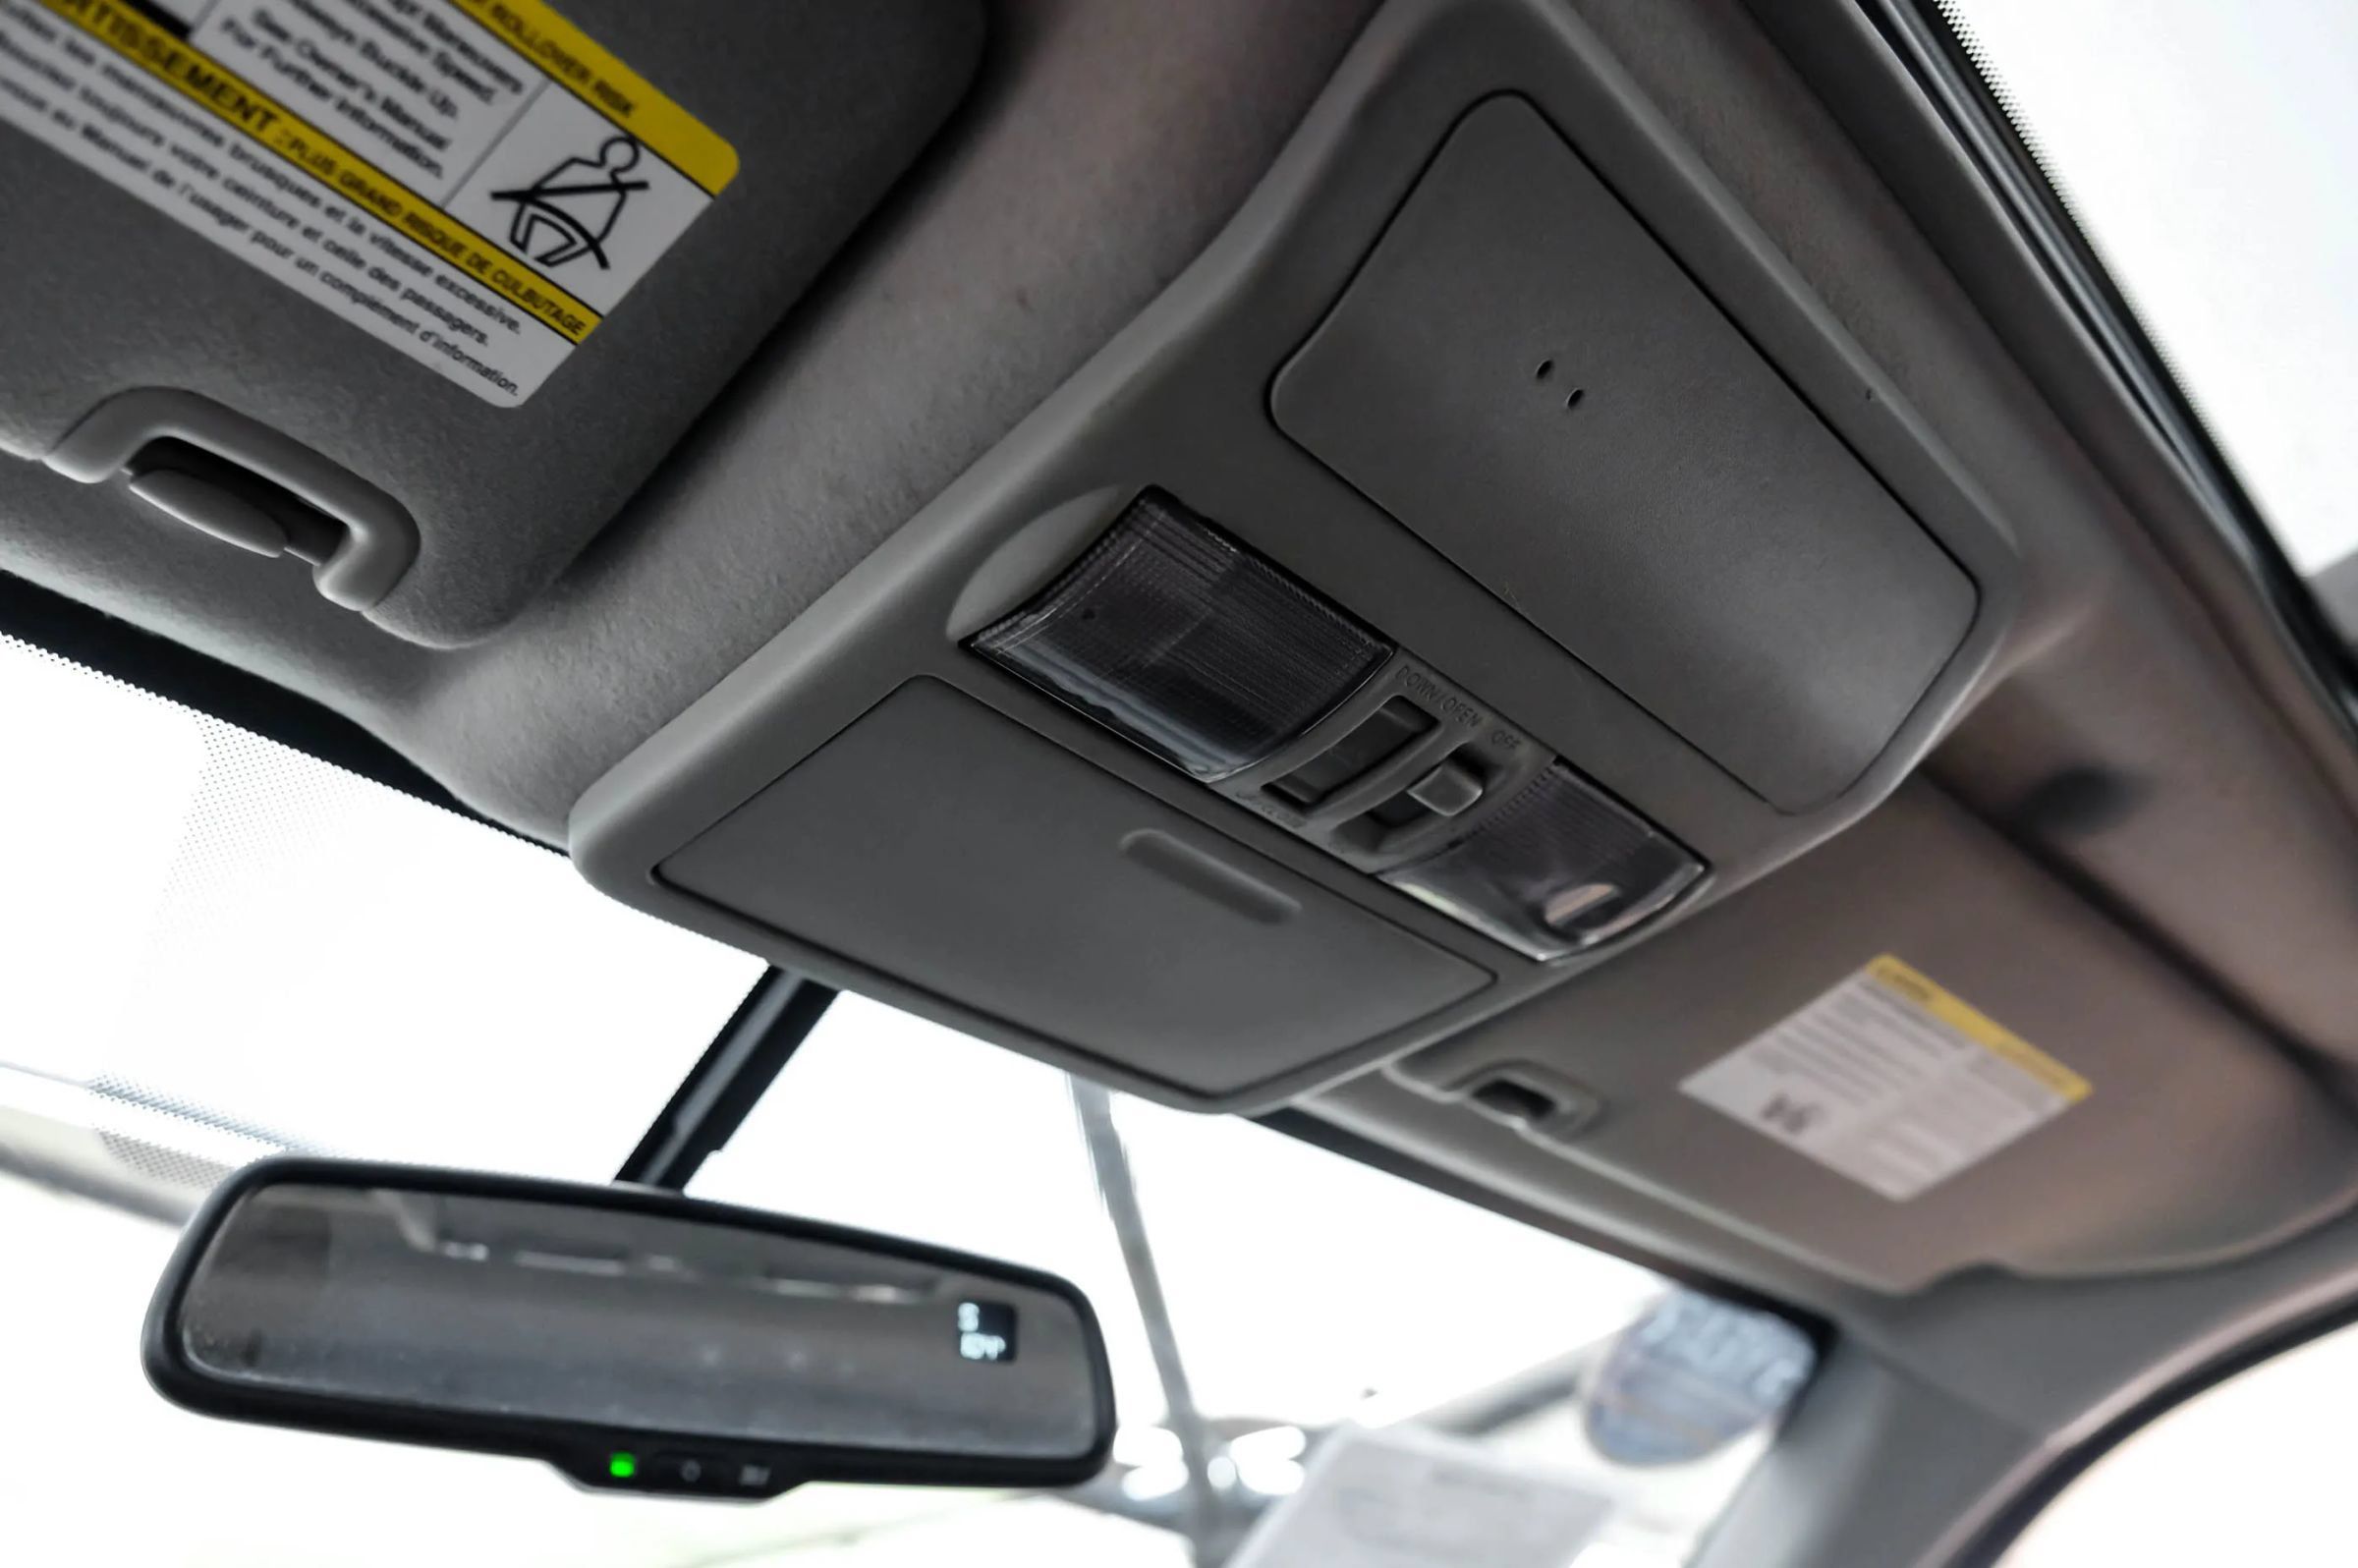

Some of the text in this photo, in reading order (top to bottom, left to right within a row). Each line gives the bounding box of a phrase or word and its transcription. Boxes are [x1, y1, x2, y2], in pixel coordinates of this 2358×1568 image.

[246, 229, 296, 261] pour
[292, 254, 322, 277] un
[488, 267, 588, 336] CULBUTAGE
[1490, 730, 1522, 750] OFF
